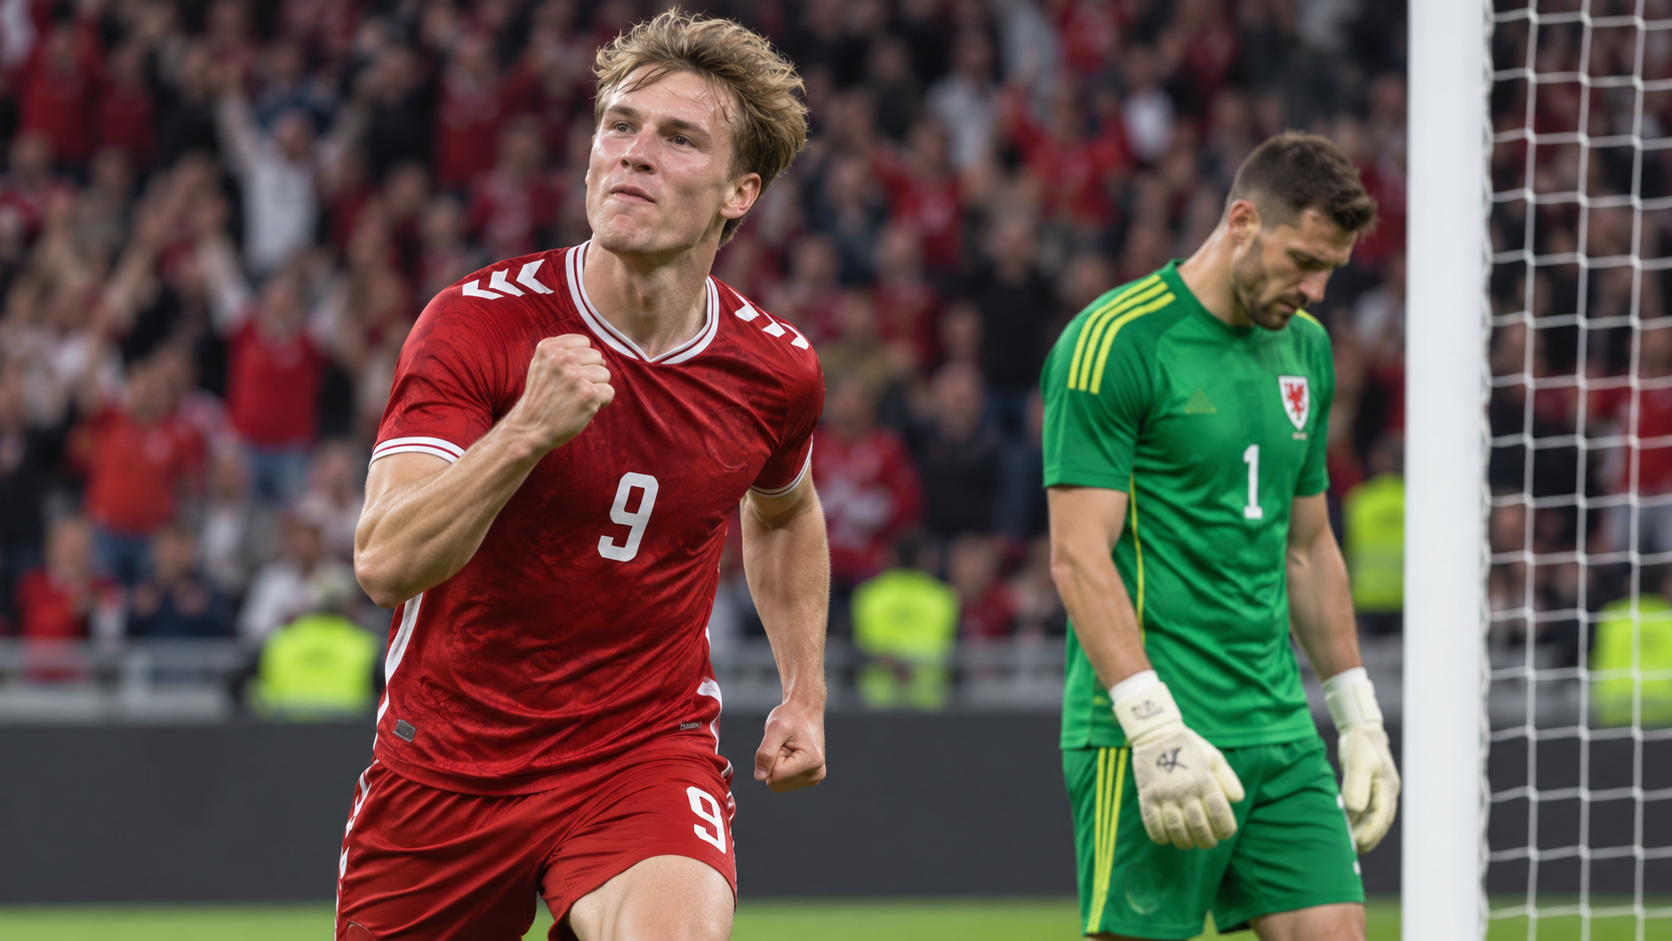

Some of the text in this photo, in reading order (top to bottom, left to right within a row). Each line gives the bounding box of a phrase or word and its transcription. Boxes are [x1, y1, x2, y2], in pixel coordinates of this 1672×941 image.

[597, 471, 660, 563] 9
[1243, 444, 1263, 519] 1
[686, 786, 727, 855] 9
